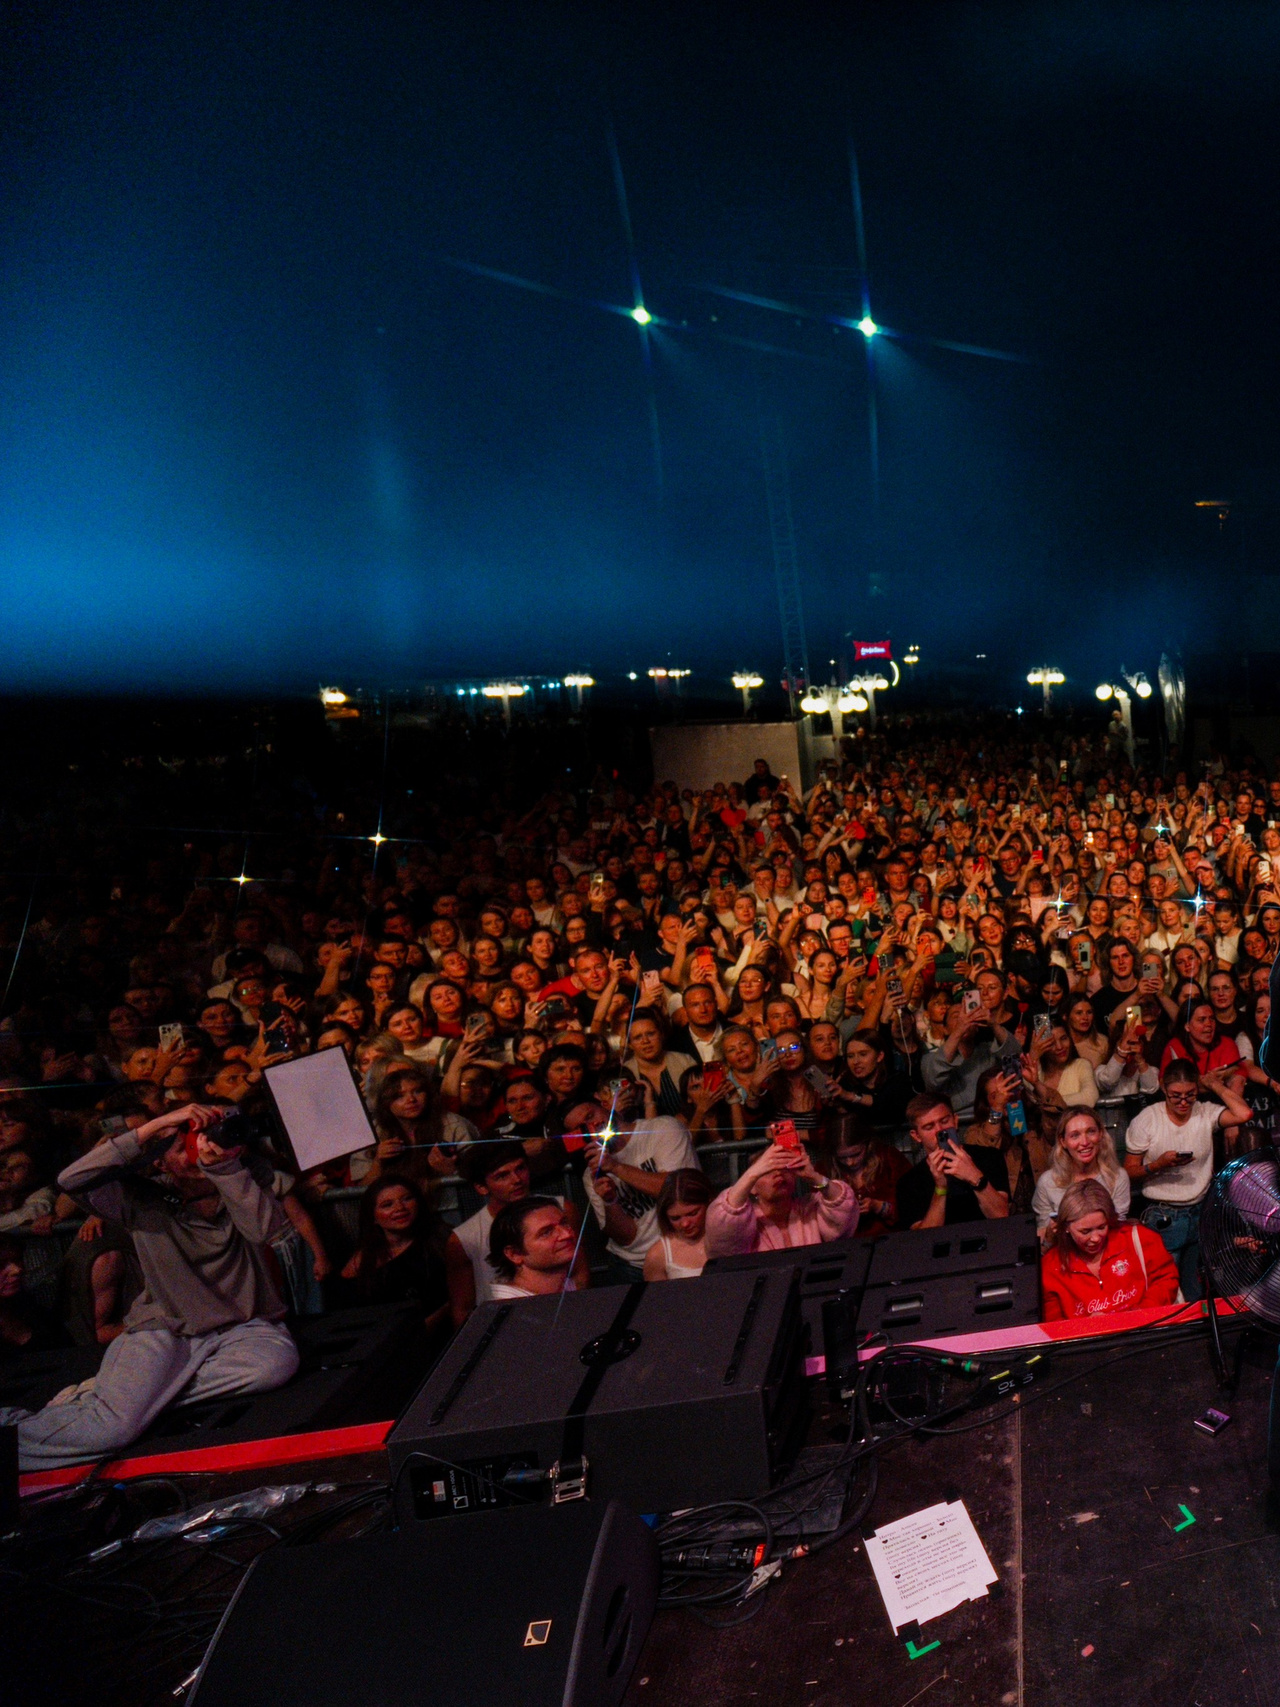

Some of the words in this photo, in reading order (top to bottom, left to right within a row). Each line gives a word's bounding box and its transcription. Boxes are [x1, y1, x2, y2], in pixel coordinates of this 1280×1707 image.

[1074, 1303, 1085, 1316] Le
[1087, 1297, 1110, 1314] Club
[1112, 1285, 1138, 1306] Privé
